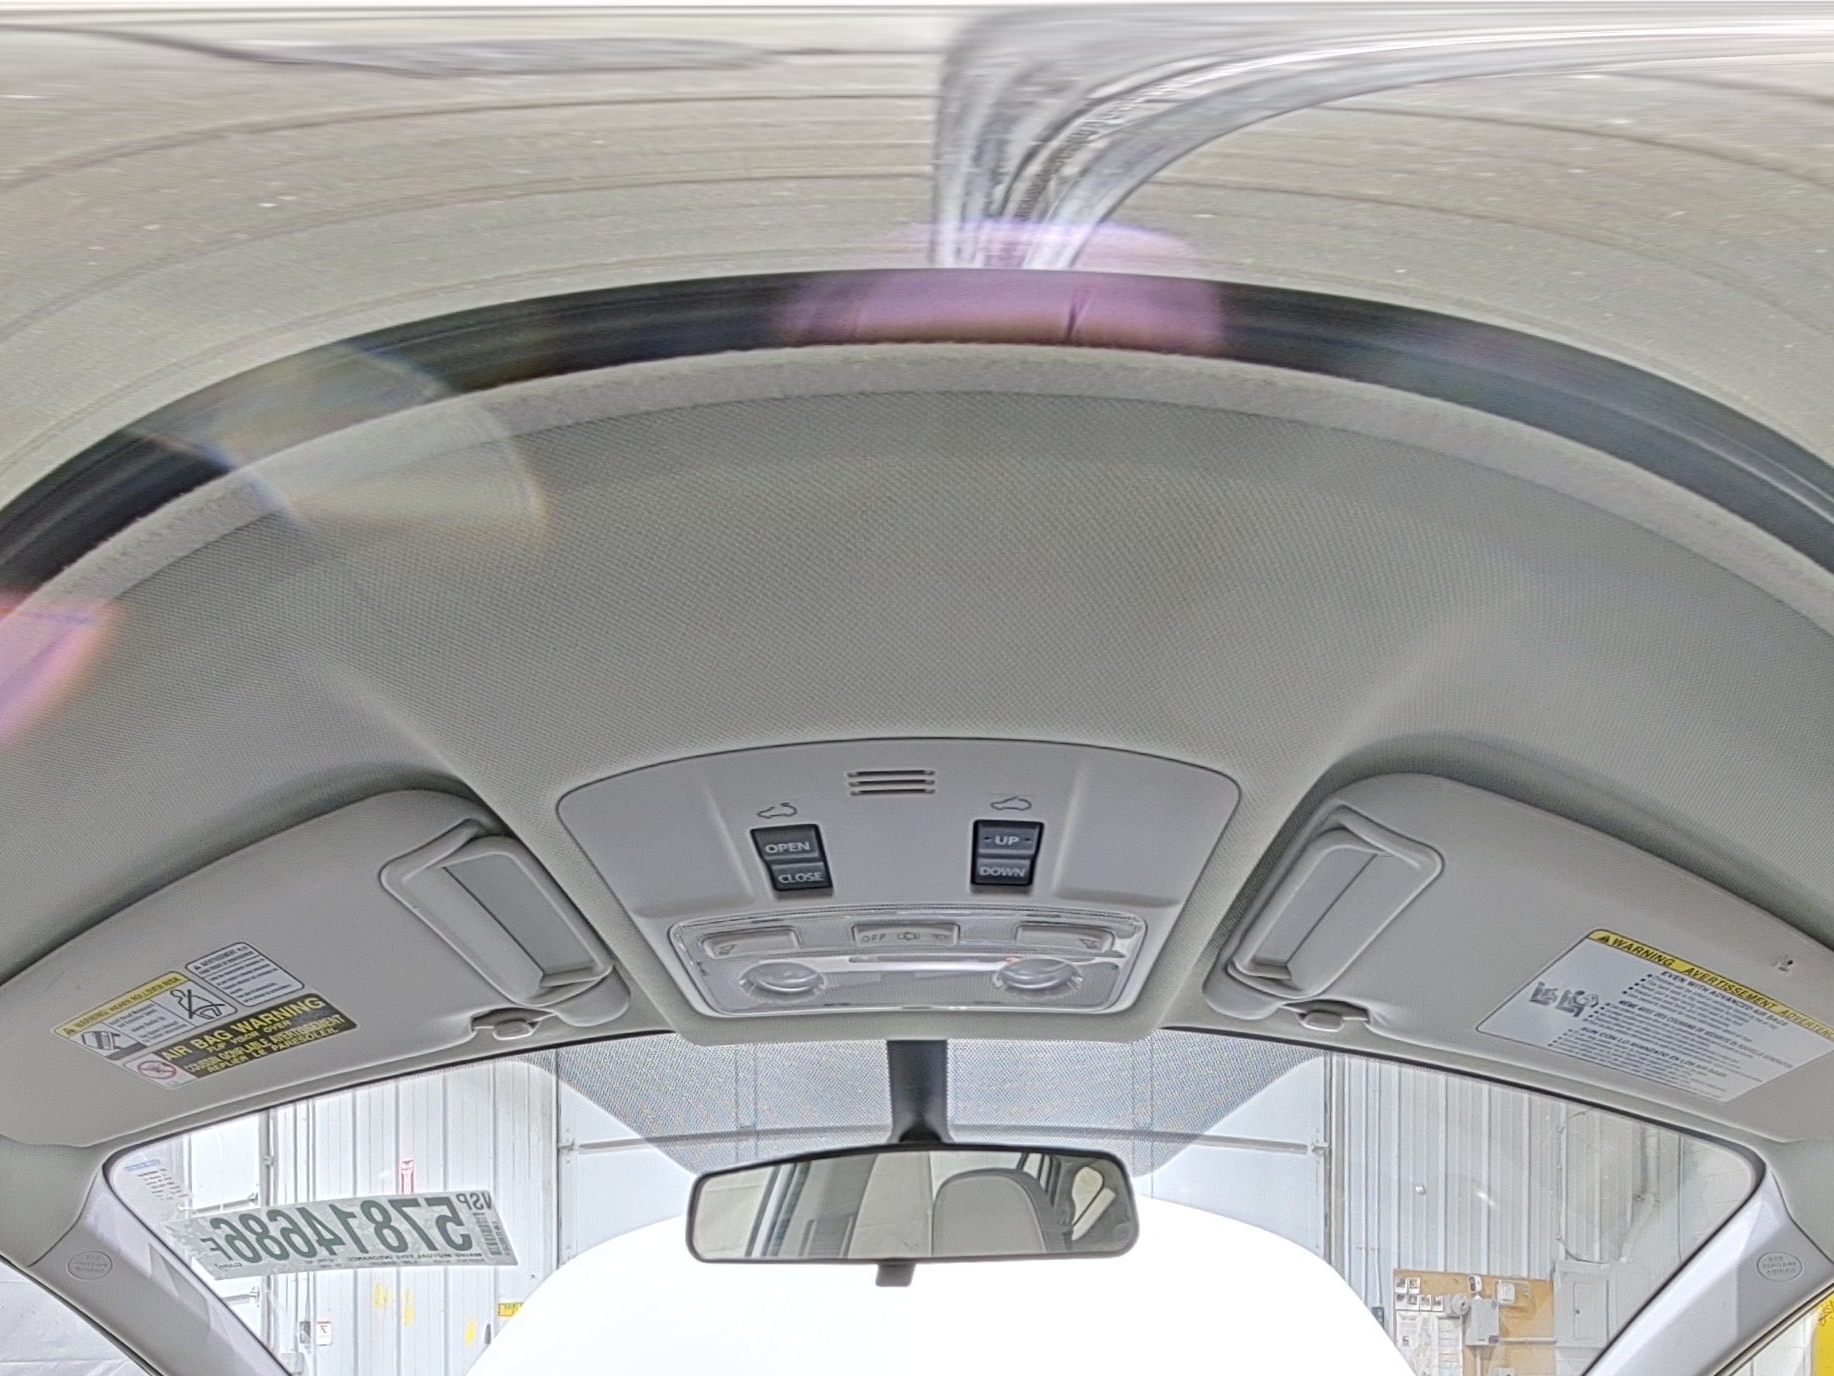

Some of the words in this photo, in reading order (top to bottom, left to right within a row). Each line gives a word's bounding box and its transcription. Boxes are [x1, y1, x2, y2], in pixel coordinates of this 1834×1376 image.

[995, 835, 1020, 846] UP
[765, 841, 810, 854] OPEN
[778, 871, 824, 884] CLOSE
[979, 866, 1026, 878] DOWN
[1614, 937, 1676, 968] WARNING
[1684, 967, 1778, 1011] AVERTISSEMENT
[1660, 971, 1686, 986] EVEN
[1686, 980, 1710, 994] WITH
[1711, 990, 1752, 1012] ADVANCED
[162, 1045, 193, 1061] AIR
[190, 1029, 233, 1051] BAG
[230, 997, 327, 1035] WARNING
